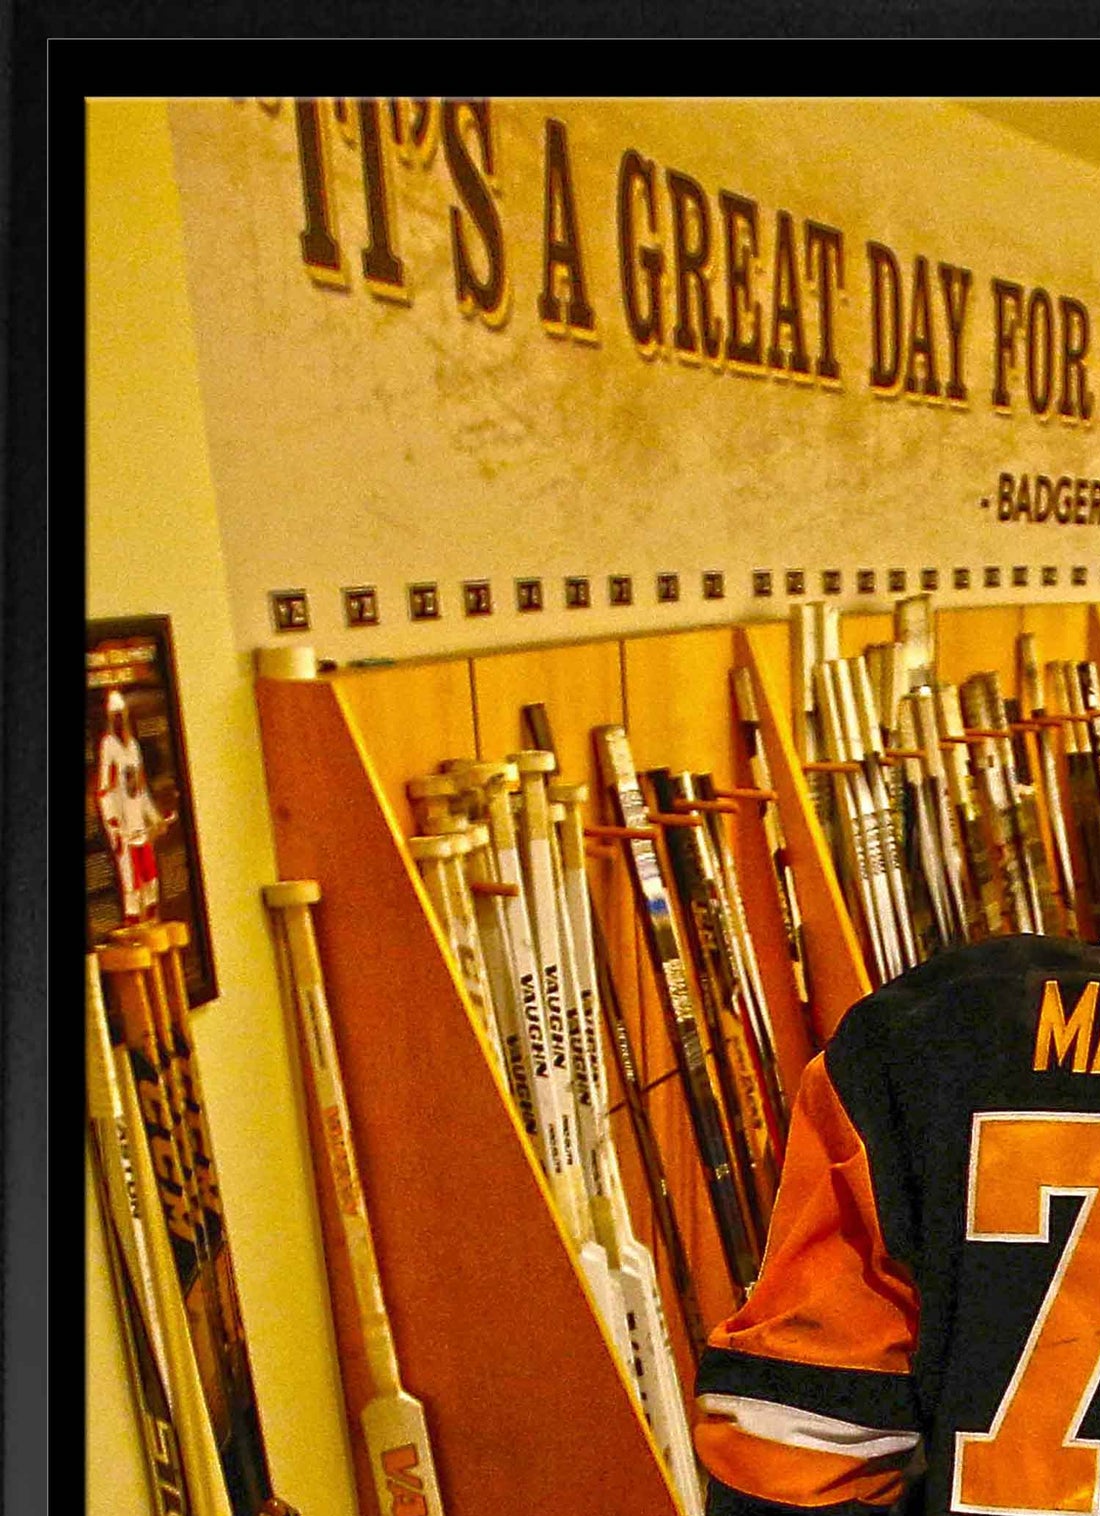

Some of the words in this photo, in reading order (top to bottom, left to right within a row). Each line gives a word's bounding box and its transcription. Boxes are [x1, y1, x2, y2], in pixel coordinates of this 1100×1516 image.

[537, 117, 597, 332] A
[616, 147, 846, 381] GREAT
[866, 239, 974, 403] DAY
[989, 275, 1094, 421] FOR
[520, 973, 549, 1079] VAUGHN
[545, 964, 566, 1071] VAUGHN
